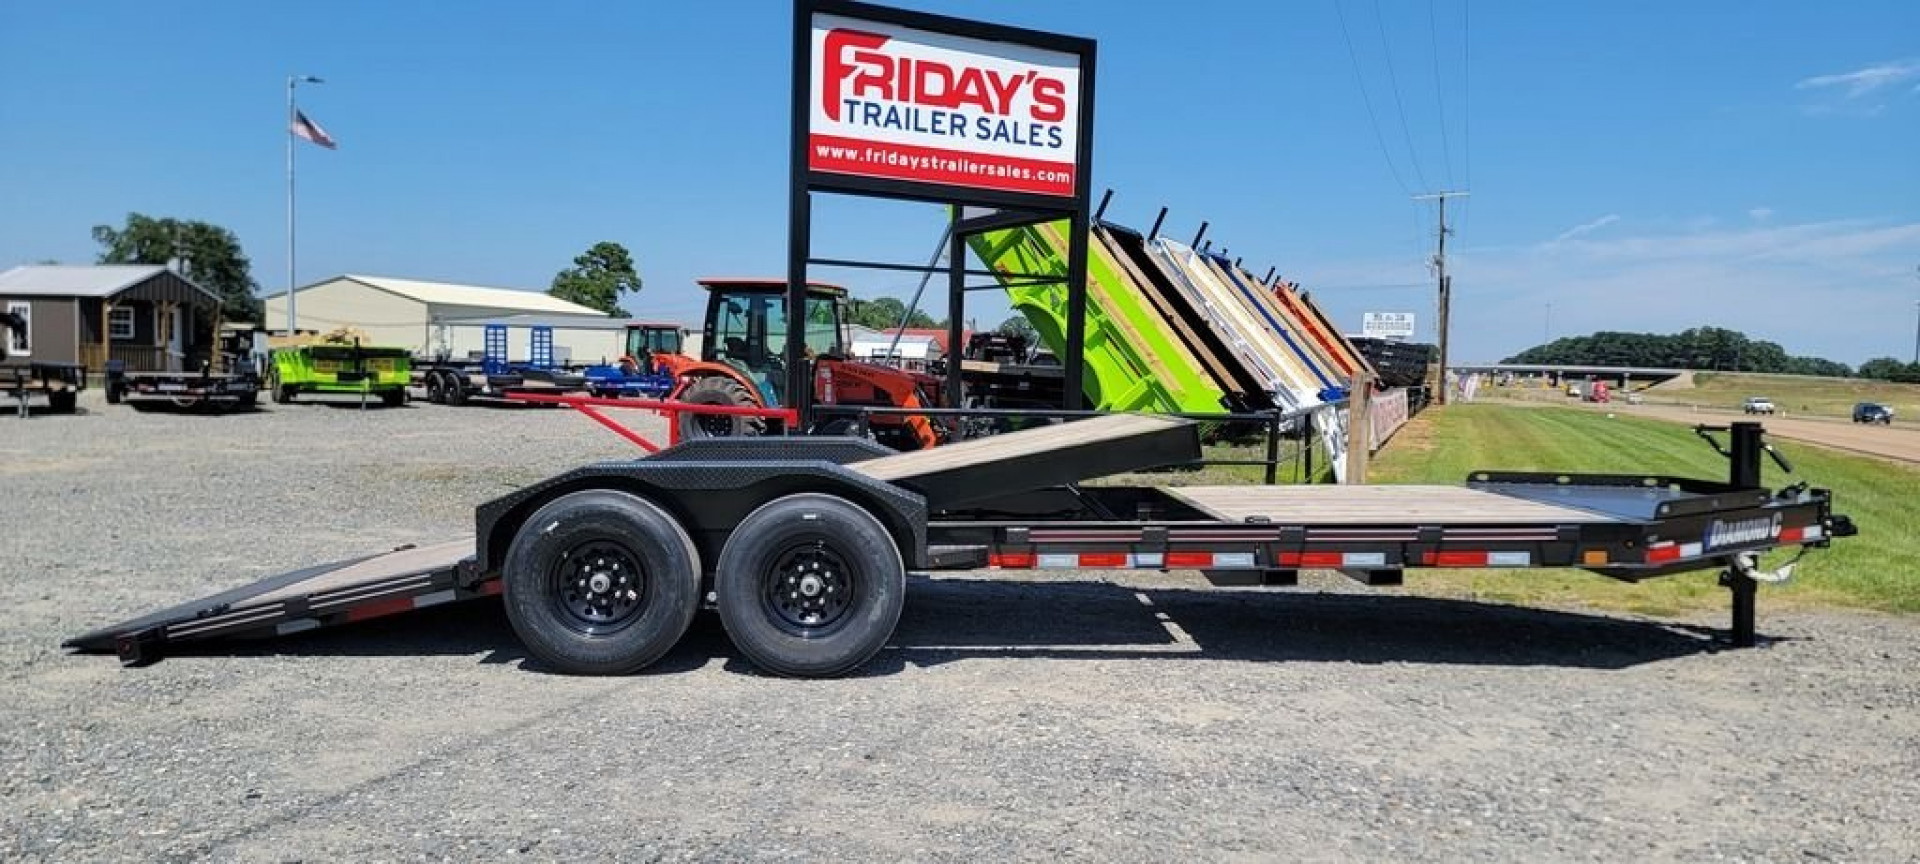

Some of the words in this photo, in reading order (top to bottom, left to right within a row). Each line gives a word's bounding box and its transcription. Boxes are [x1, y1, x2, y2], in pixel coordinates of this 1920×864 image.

[823, 28, 1066, 123] FRIDAY'S
[844, 99, 966, 138] TRAILER
[976, 117, 1063, 149] SALES
[816, 143, 1070, 184] www.fridaystrailersales.com
[1709, 518, 1769, 547] DIAMOND
[1771, 511, 1783, 537] C
